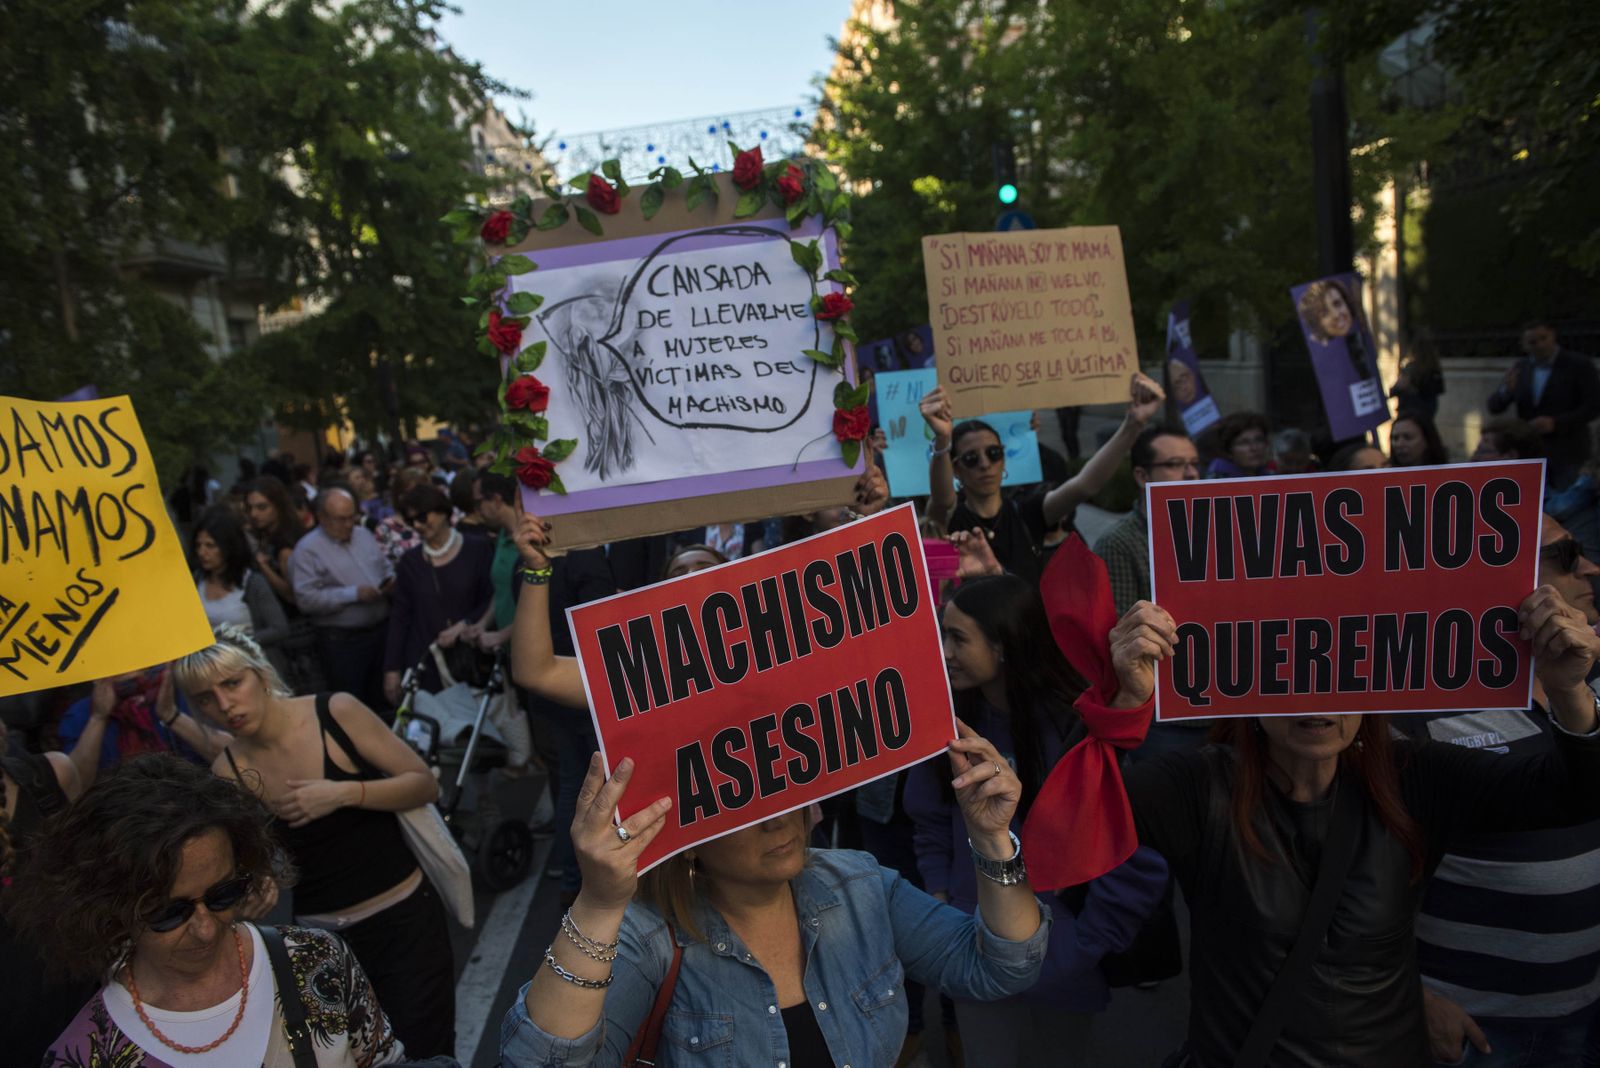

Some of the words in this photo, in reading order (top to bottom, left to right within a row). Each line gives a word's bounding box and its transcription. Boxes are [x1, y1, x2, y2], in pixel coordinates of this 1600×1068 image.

[968, 239, 1028, 268] MAÑANA
[1030, 242, 1053, 264] SOY
[647, 261, 772, 297] CANSADA
[964, 272, 1023, 296] MAÑANA
[637, 308, 673, 330] DE
[691, 303, 809, 328] LLEVARME
[944, 299, 1044, 328] DESTRÚYELO
[633, 340, 646, 358] A
[664, 335, 769, 358] MUJERES
[969, 330, 1026, 354] MAÑANA
[1029, 331, 1047, 347] ME
[1052, 326, 1084, 345] TOCA
[1089, 325, 1098, 341] A
[753, 360, 806, 378] DEL
[1016, 360, 1042, 382] SER
[1047, 359, 1063, 379] LA
[1166, 487, 1366, 582] VIVAS
[1384, 477, 1521, 572] NOS
[0, 567, 104, 681] MENOS
[596, 531, 919, 721] MACHISMO
[1172, 606, 1520, 706] QUEREMOS
[675, 667, 912, 827] ASESINO
